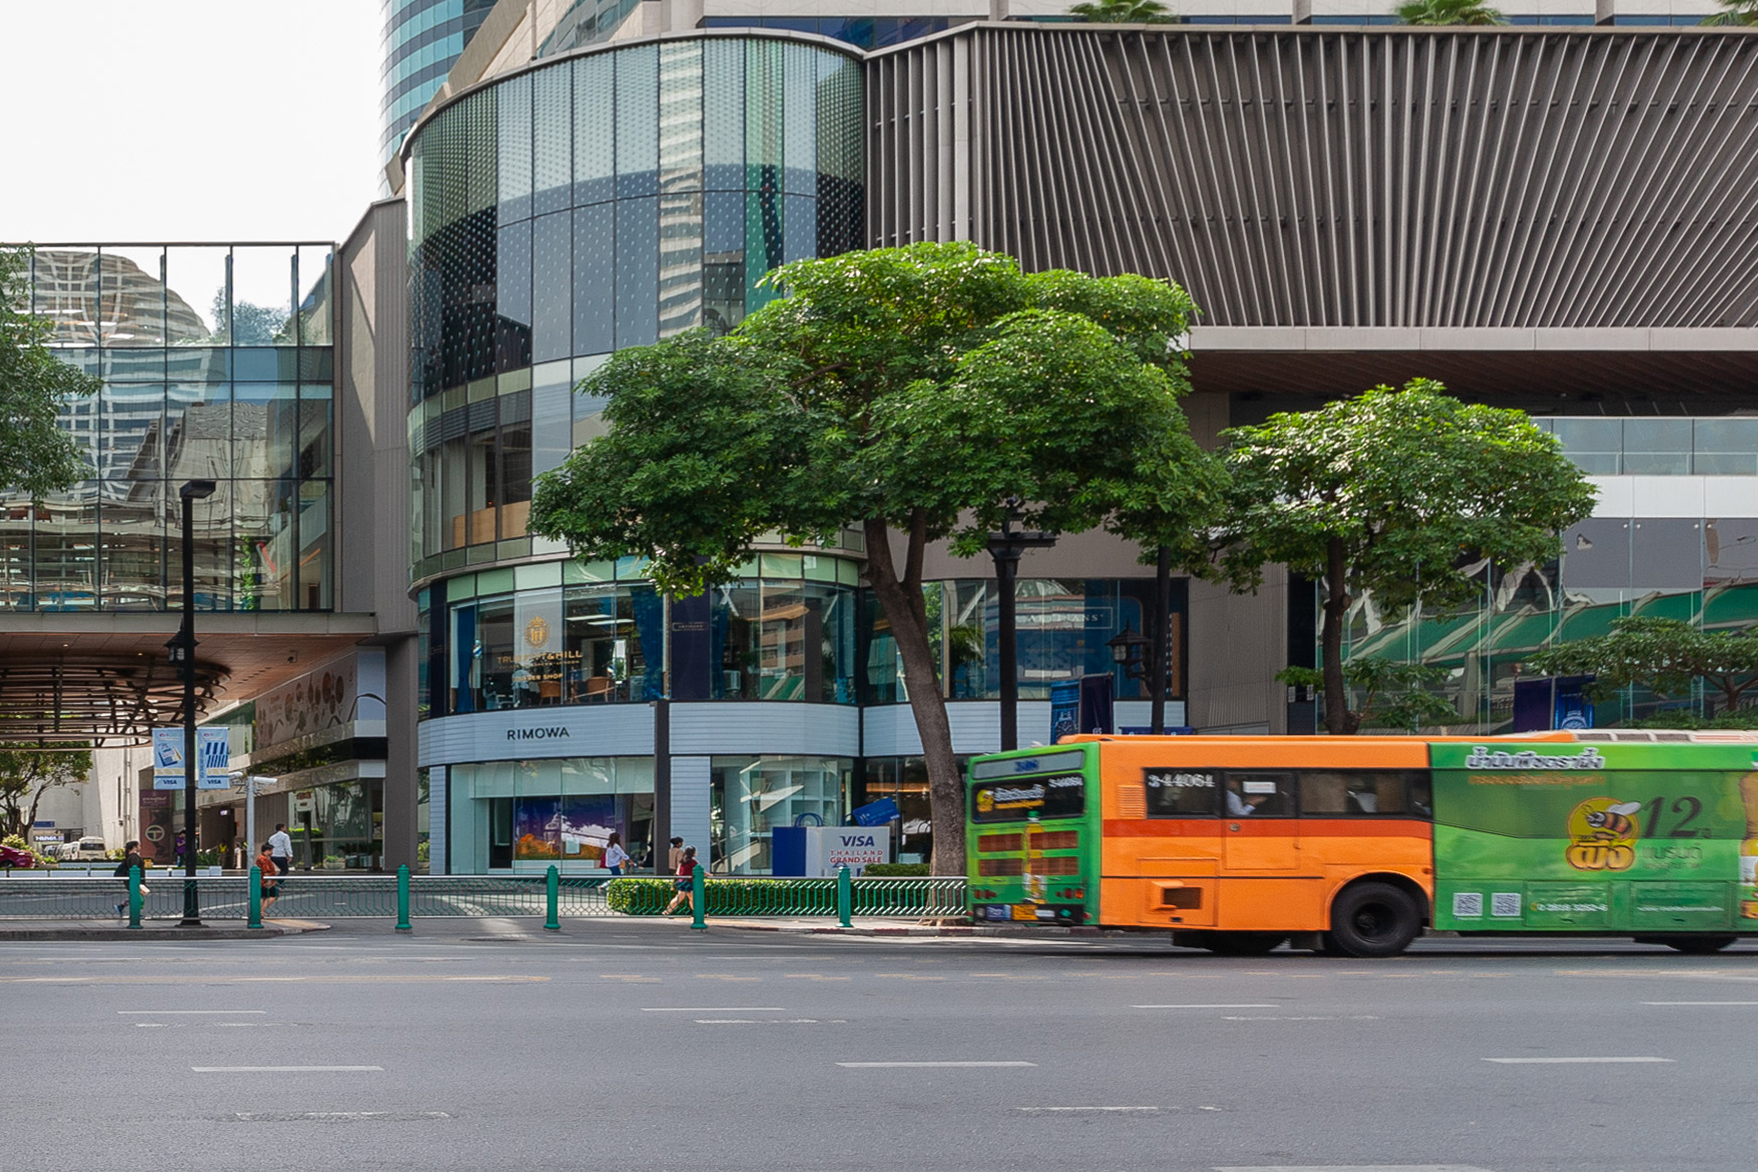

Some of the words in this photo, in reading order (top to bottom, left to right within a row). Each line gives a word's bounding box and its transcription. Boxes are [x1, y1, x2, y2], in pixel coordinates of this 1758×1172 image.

[507, 727, 570, 740] RIMOWA
[1643, 796, 1702, 839] 12
[839, 835, 875, 847] VISA
[830, 856, 860, 864] GRAND
[862, 856, 882, 864] SALE
